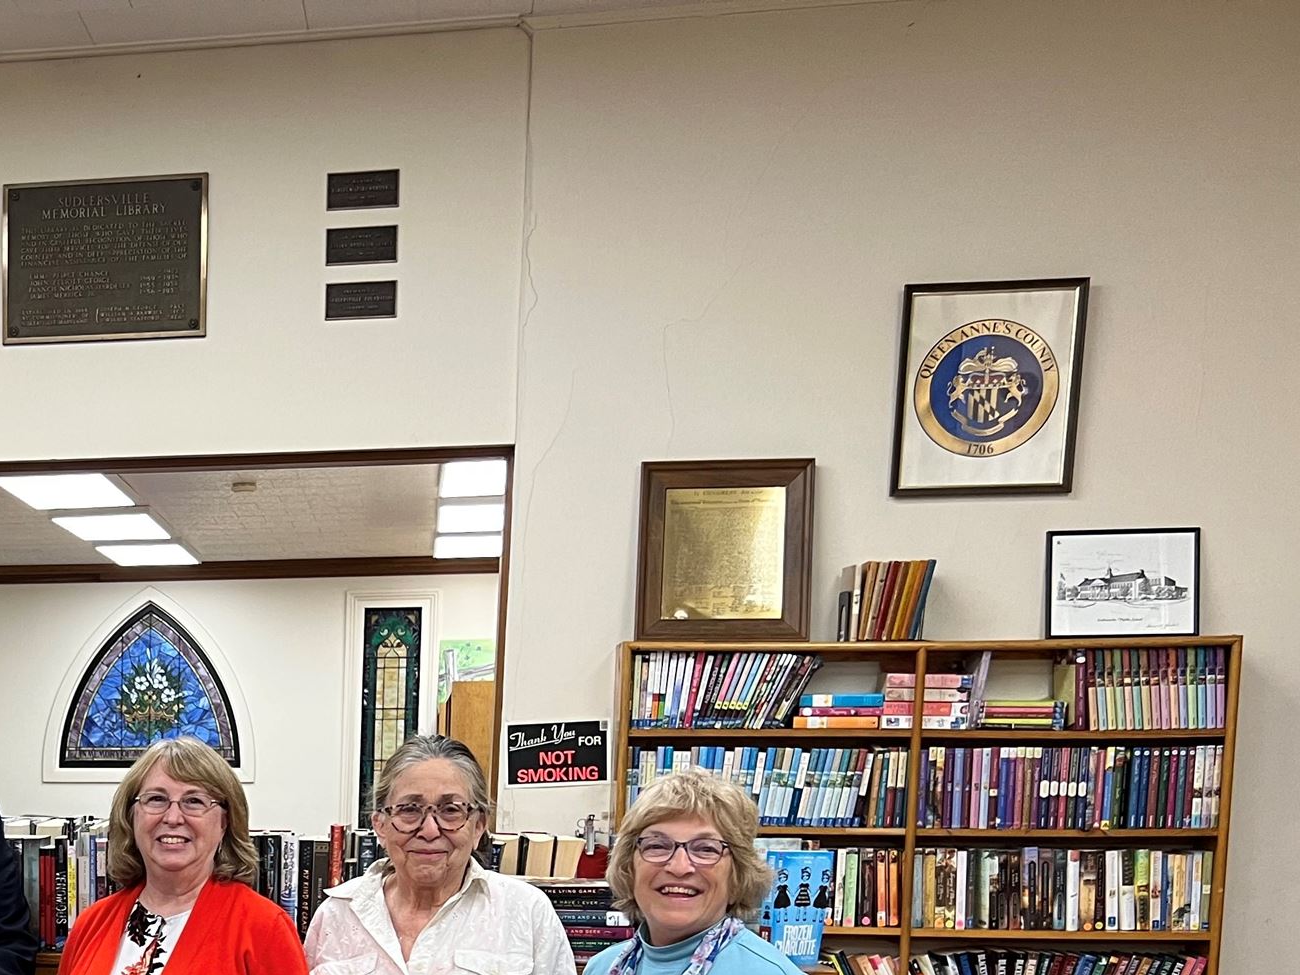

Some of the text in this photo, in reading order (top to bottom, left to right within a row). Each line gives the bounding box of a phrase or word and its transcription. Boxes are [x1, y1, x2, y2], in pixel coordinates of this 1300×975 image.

[59, 193, 149, 207] SUDLERSVILLE
[42, 203, 166, 219] MEMORIAL LIBRARY
[920, 321, 1056, 379] QUEEN ANNE'S COUNTY
[965, 442, 994, 455] 1706
[704, 667, 718, 703] FORGOTTEN
[510, 723, 602, 748] Thank You FOR
[539, 750, 576, 765] NOT
[517, 766, 598, 783] SMOKING
[56, 871, 67, 924] VENOMOUS
[302, 911, 310, 934] CRAZY
[784, 924, 813, 941] FROZEN
[775, 939, 817, 956] CHARLOTTE
